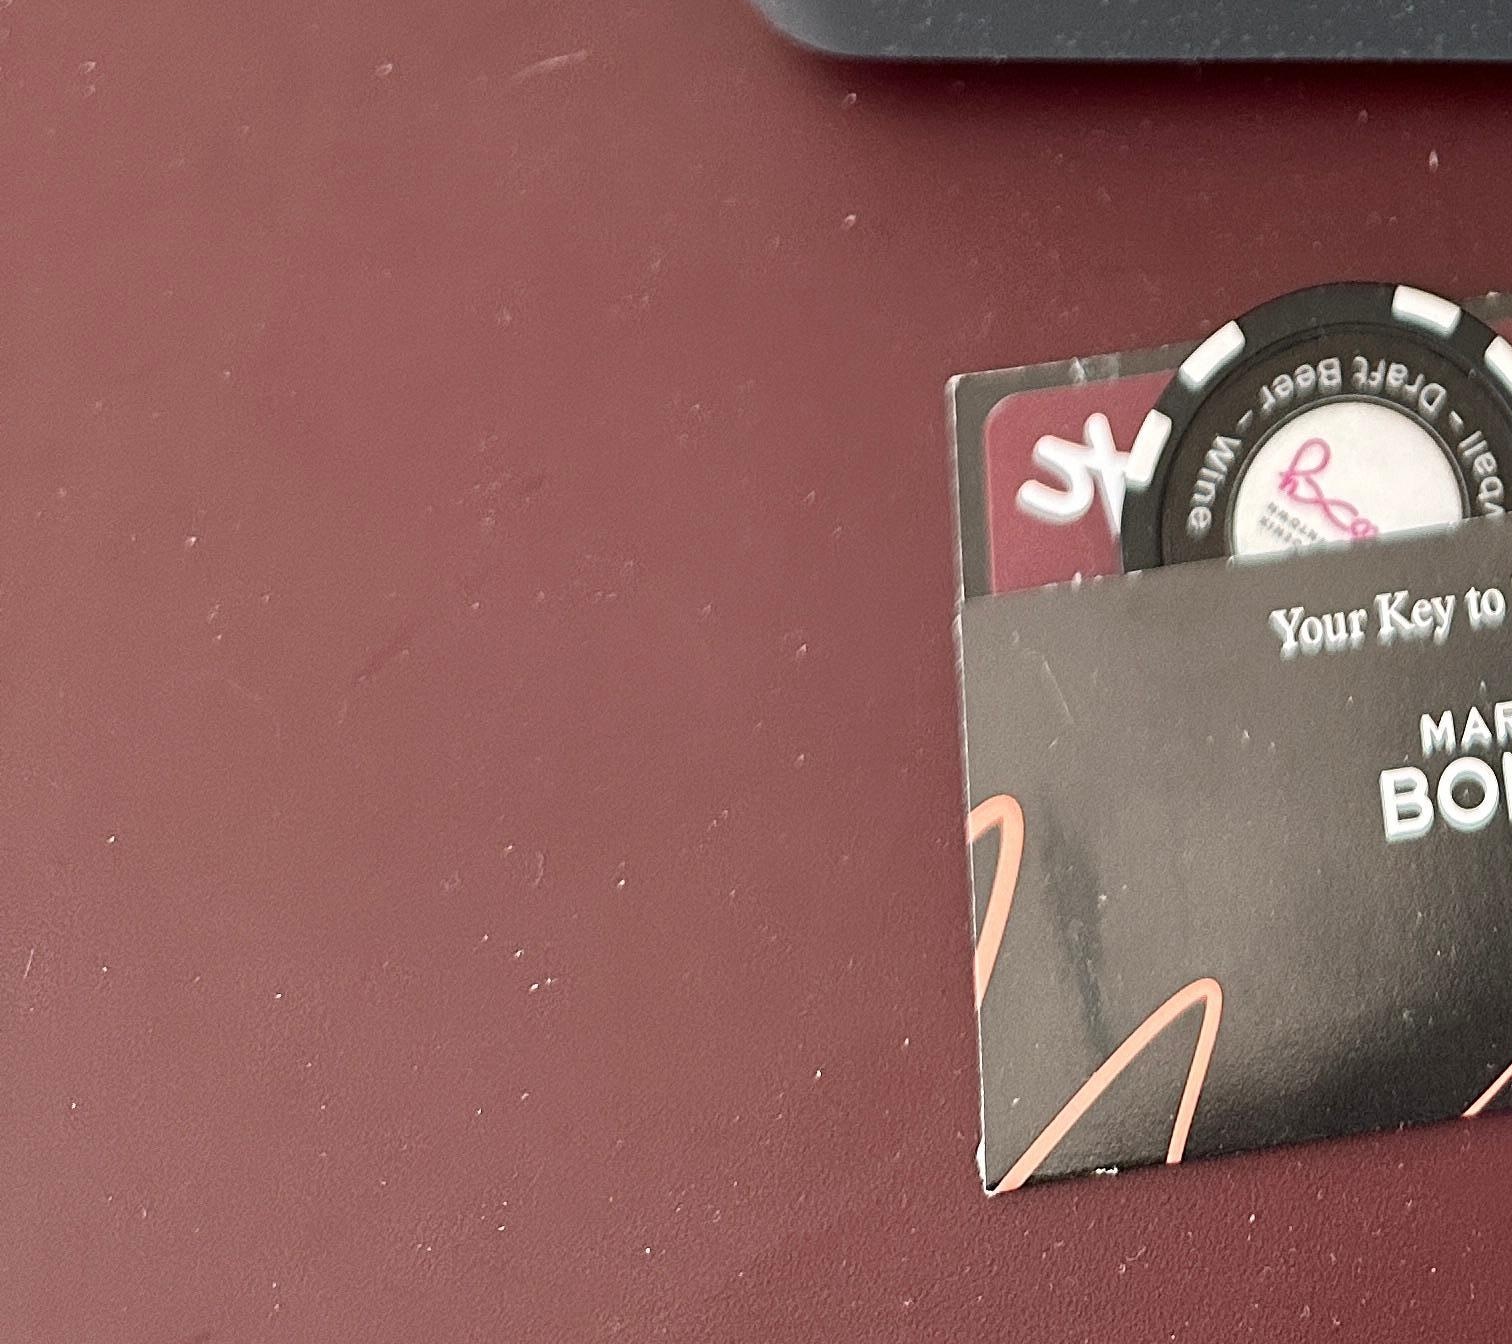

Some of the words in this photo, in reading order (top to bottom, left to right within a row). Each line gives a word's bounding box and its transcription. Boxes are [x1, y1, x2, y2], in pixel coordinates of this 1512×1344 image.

[1258, 356, 1342, 416] Beer
[1351, 355, 1447, 424] Draft
[1186, 434, 1242, 537] Wine
[1269, 606, 1366, 661] Your
[1374, 590, 1455, 646] Key
[1465, 585, 1506, 628] to
